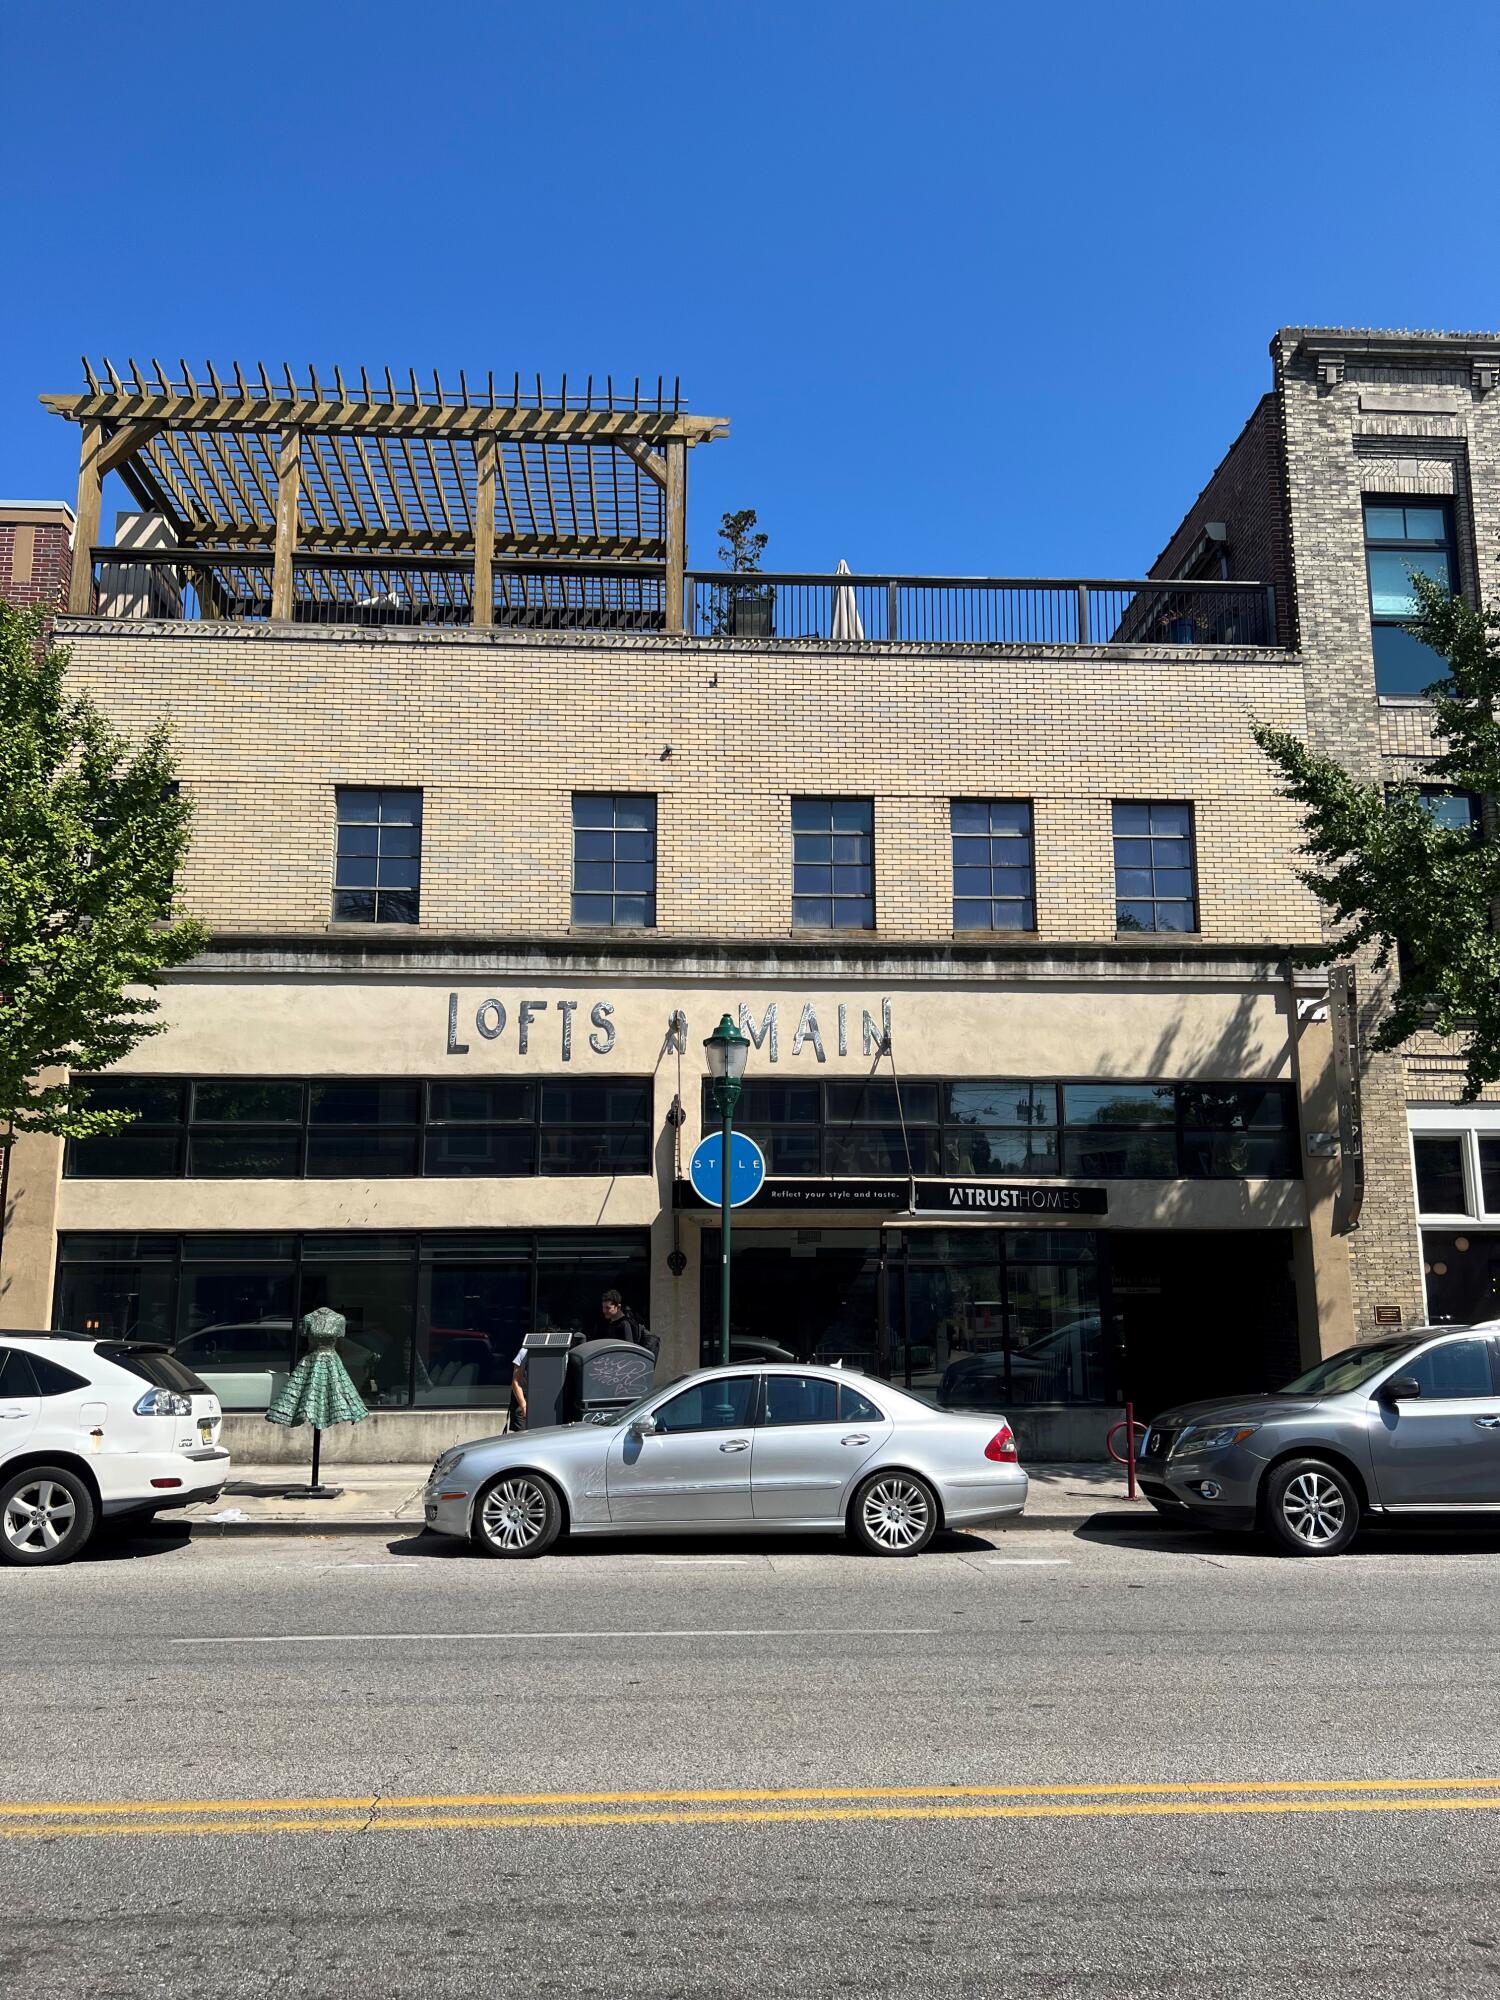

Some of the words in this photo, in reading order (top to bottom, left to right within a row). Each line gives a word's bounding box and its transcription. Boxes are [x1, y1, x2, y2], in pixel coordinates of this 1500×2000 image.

[447, 993, 615, 1061] LOFTS
[739, 997, 891, 1062] MAIN
[694, 1160, 760, 1169] STLE
[829, 1191, 850, 1199] style
